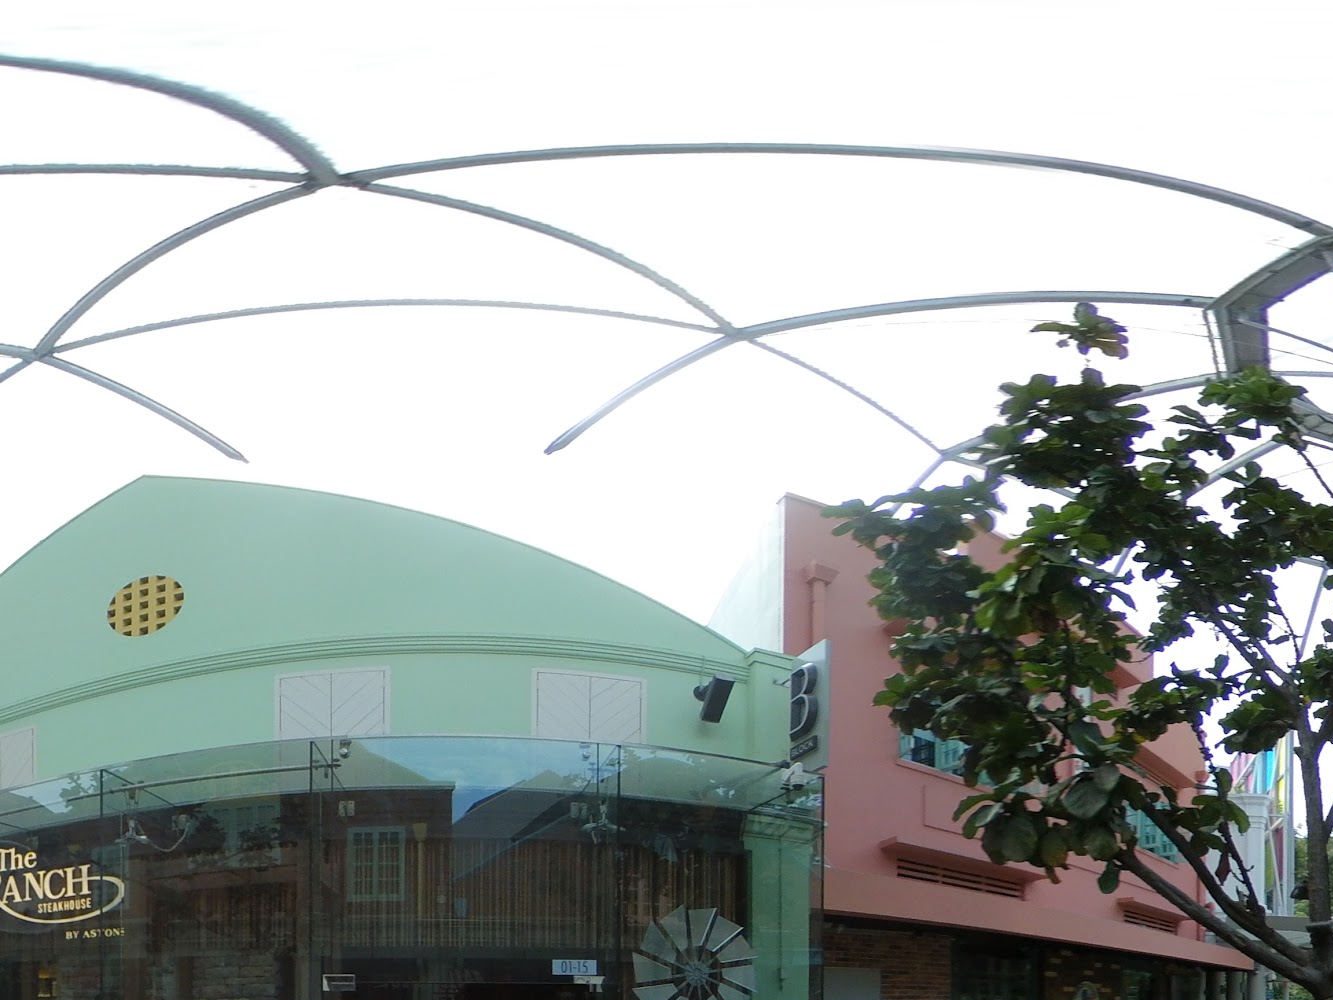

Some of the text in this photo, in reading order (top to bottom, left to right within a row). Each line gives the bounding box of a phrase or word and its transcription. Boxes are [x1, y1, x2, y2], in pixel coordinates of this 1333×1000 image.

[0, 864, 92, 904] ANCH
[38, 898, 92, 914] STEAKHOUSE
[65, 930, 79, 940] BY
[561, 960, 589, 974] 01-15
